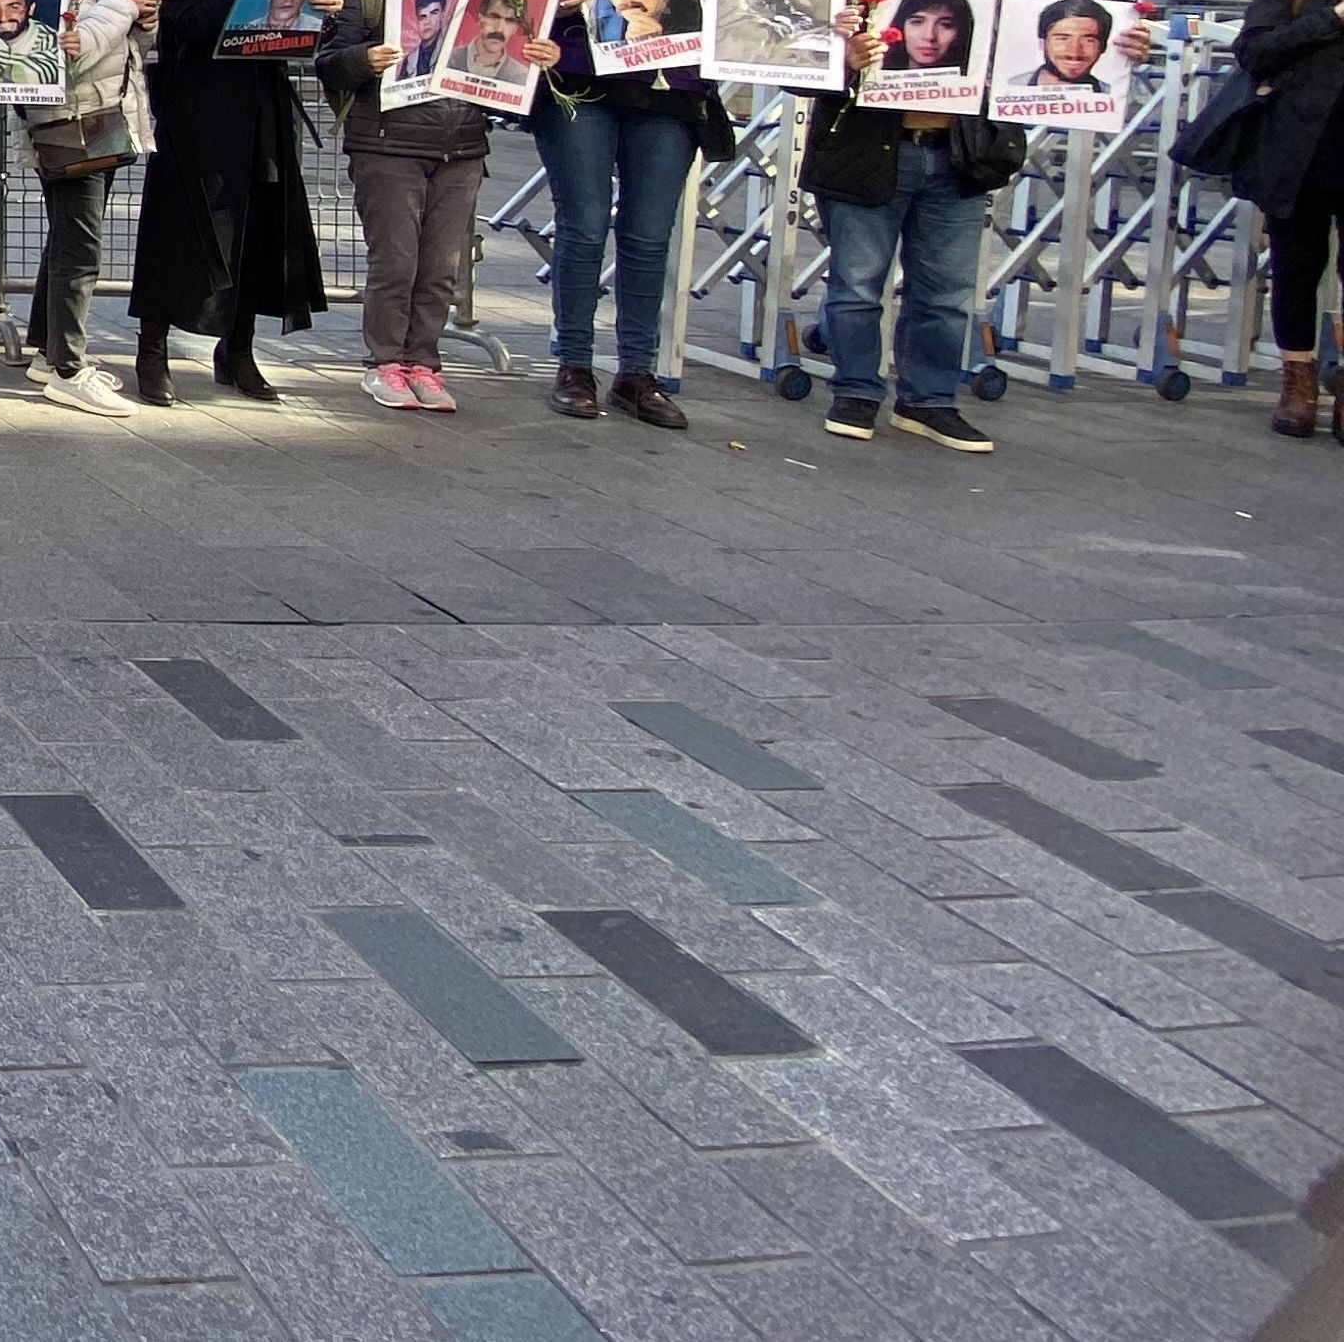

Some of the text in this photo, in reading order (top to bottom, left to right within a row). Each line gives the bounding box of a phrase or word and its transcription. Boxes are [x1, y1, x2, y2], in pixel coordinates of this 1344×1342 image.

[223, 32, 282, 47] GÖZALTINDA
[624, 38, 701, 68] KAYBEDİLDİ
[863, 86, 978, 103] KAYBEDİLDİ
[997, 100, 1115, 117] KAYBEDİLDİ
[788, 110, 806, 205] OLİS
